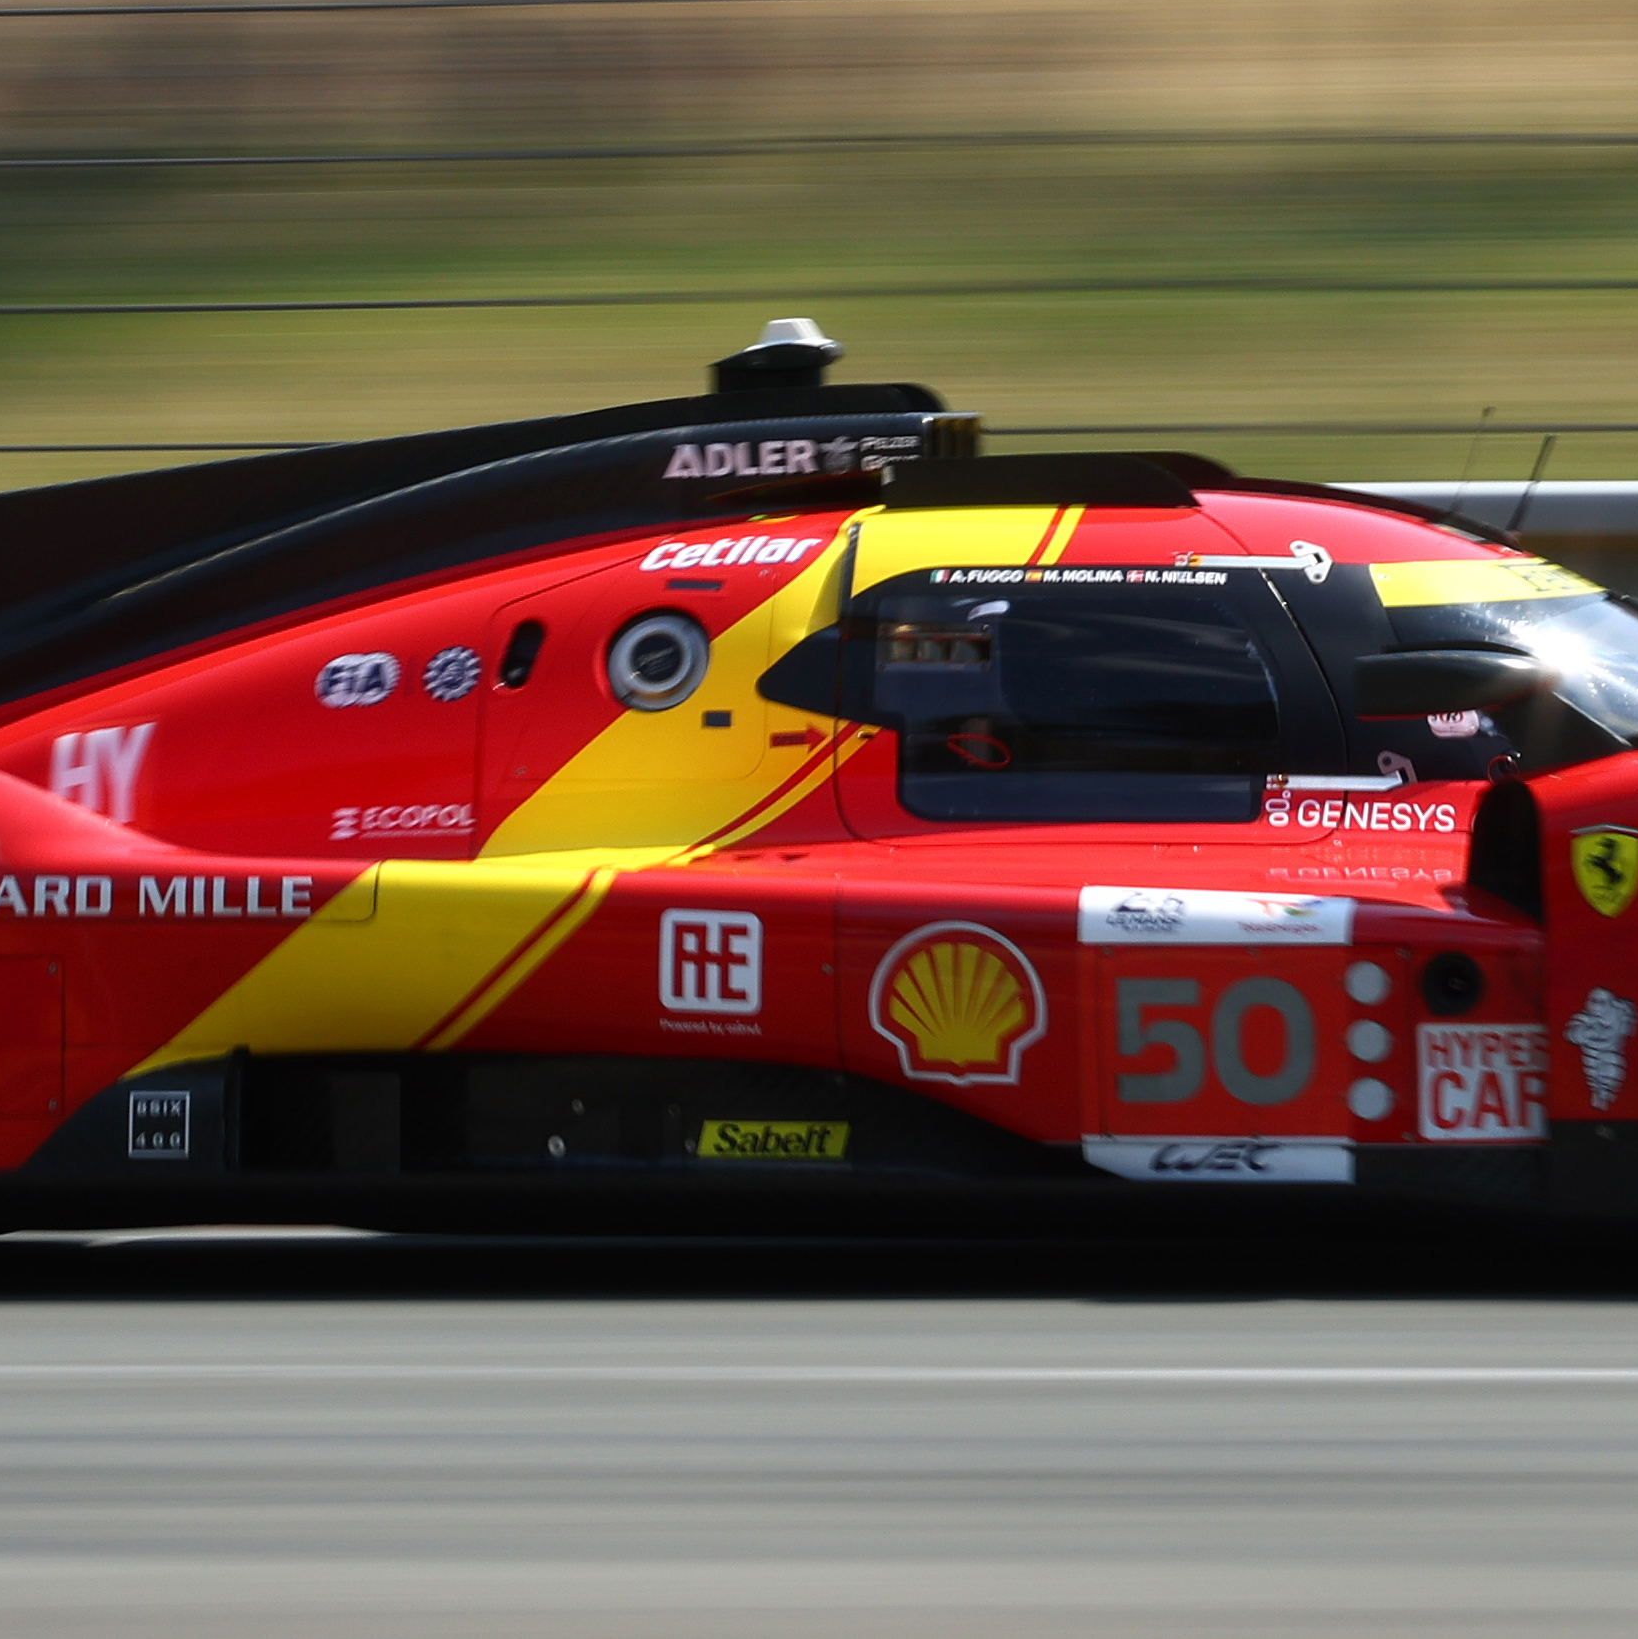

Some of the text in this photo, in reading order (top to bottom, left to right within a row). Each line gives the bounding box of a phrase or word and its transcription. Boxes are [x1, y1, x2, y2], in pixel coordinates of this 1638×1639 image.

[662, 440, 819, 479] ADLER
[641, 536, 823, 572] Cetilar
[361, 803, 477, 830] ECOPOL
[1297, 798, 1456, 833] GENESYS
[138, 875, 313, 918] MILLE
[1114, 976, 1317, 1106] 50
[136, 1131, 181, 1150] 400
[714, 1123, 831, 1153] Sabelt
[1150, 1143, 1282, 1174] WEC
